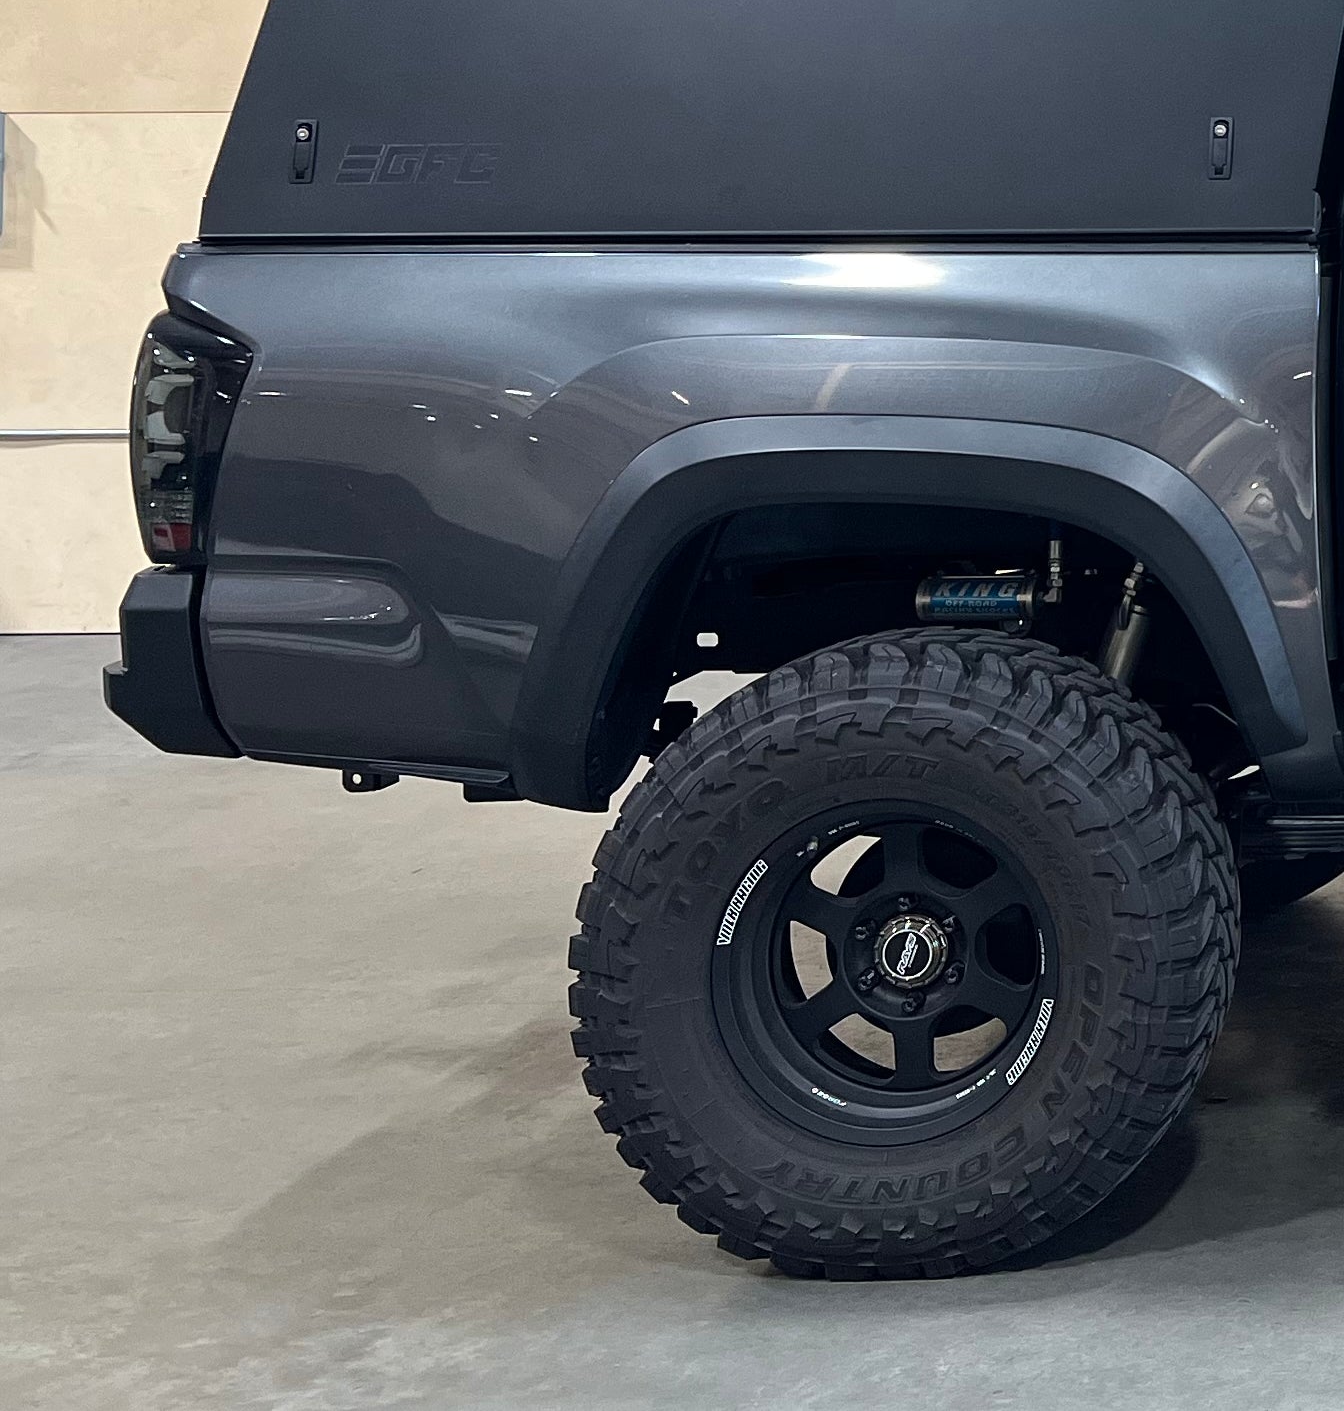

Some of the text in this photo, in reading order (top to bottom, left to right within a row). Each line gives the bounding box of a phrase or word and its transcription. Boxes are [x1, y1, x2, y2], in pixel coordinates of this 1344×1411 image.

[934, 582, 1019, 597] KING
[716, 858, 769, 946] VOLK RACING
[750, 961, 1106, 1205] OPEN COUNTRY
[1005, 998, 1055, 1086] VOLK RACING
